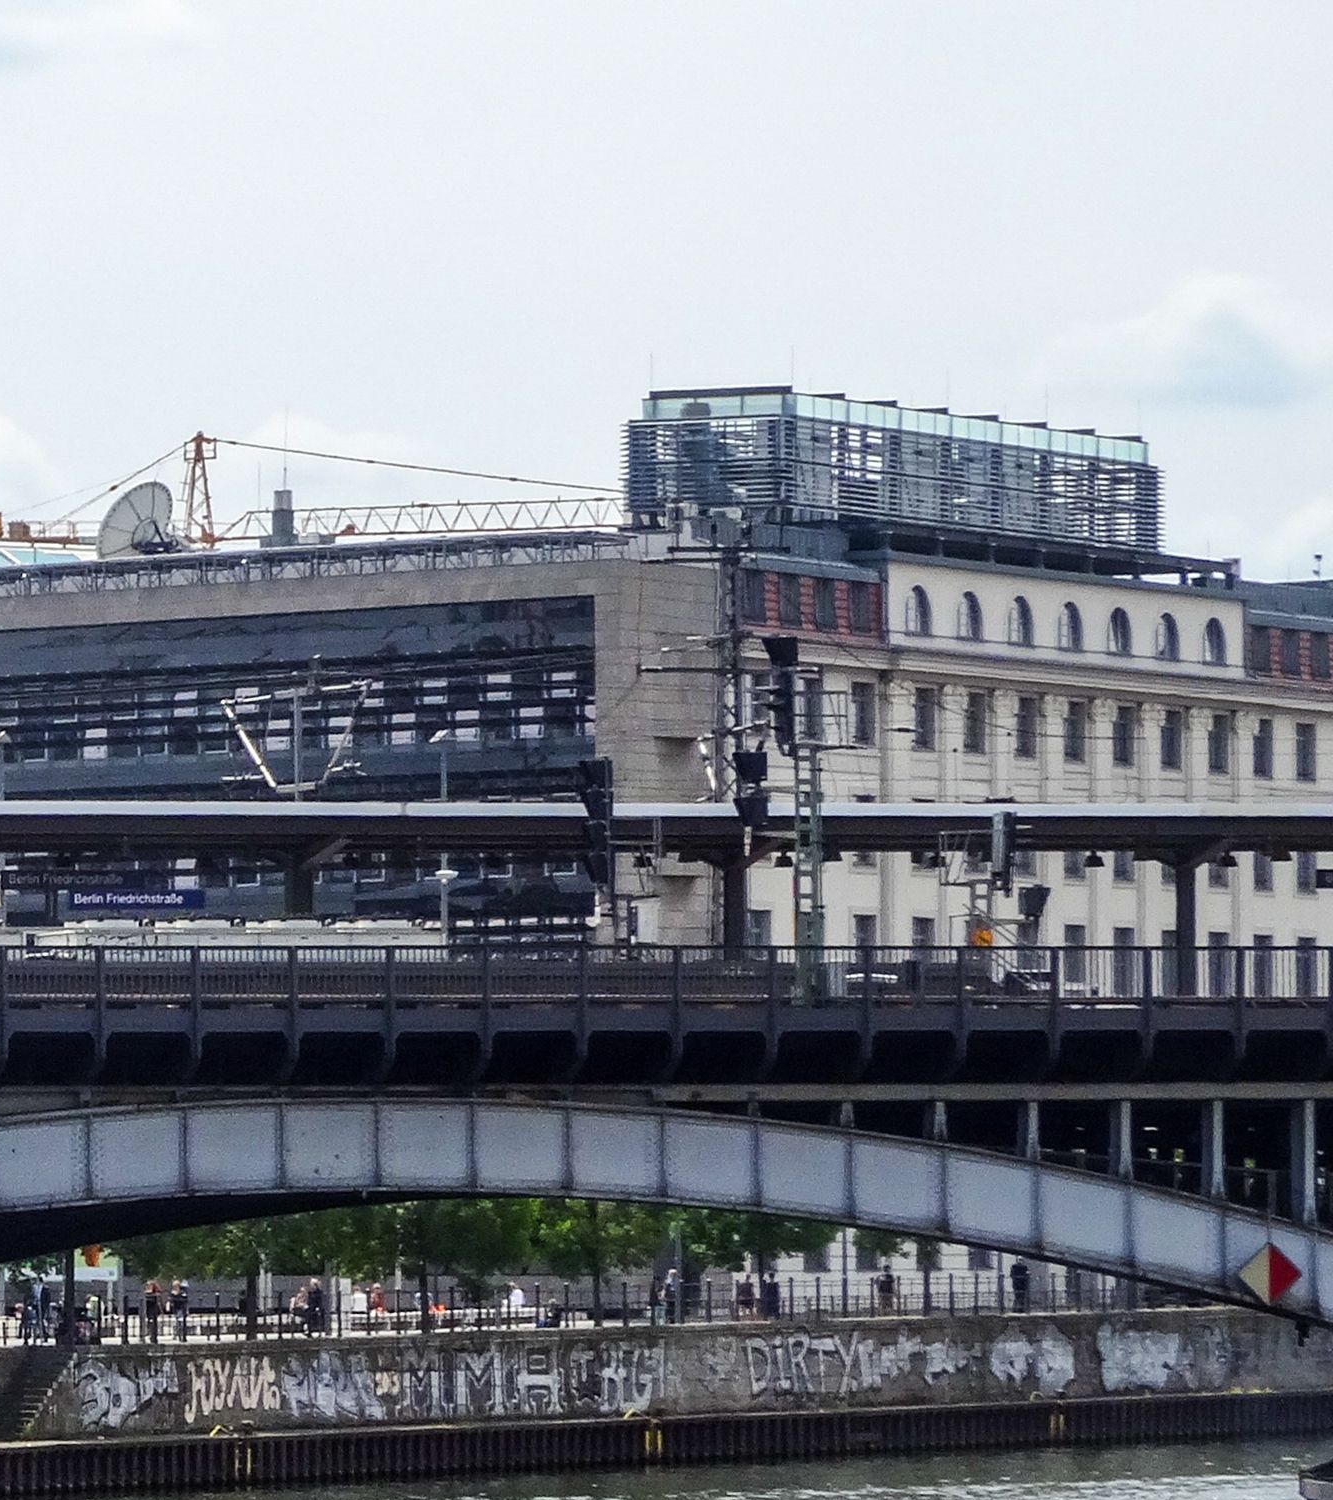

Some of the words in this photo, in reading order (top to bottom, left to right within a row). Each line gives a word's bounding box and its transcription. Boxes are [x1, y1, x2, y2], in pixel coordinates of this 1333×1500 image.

[8, 874, 40, 885] Berlin
[42, 873, 124, 885] Friedrichstraße
[74, 893, 104, 905] Berlin
[106, 893, 184, 905] Friedrichstraße
